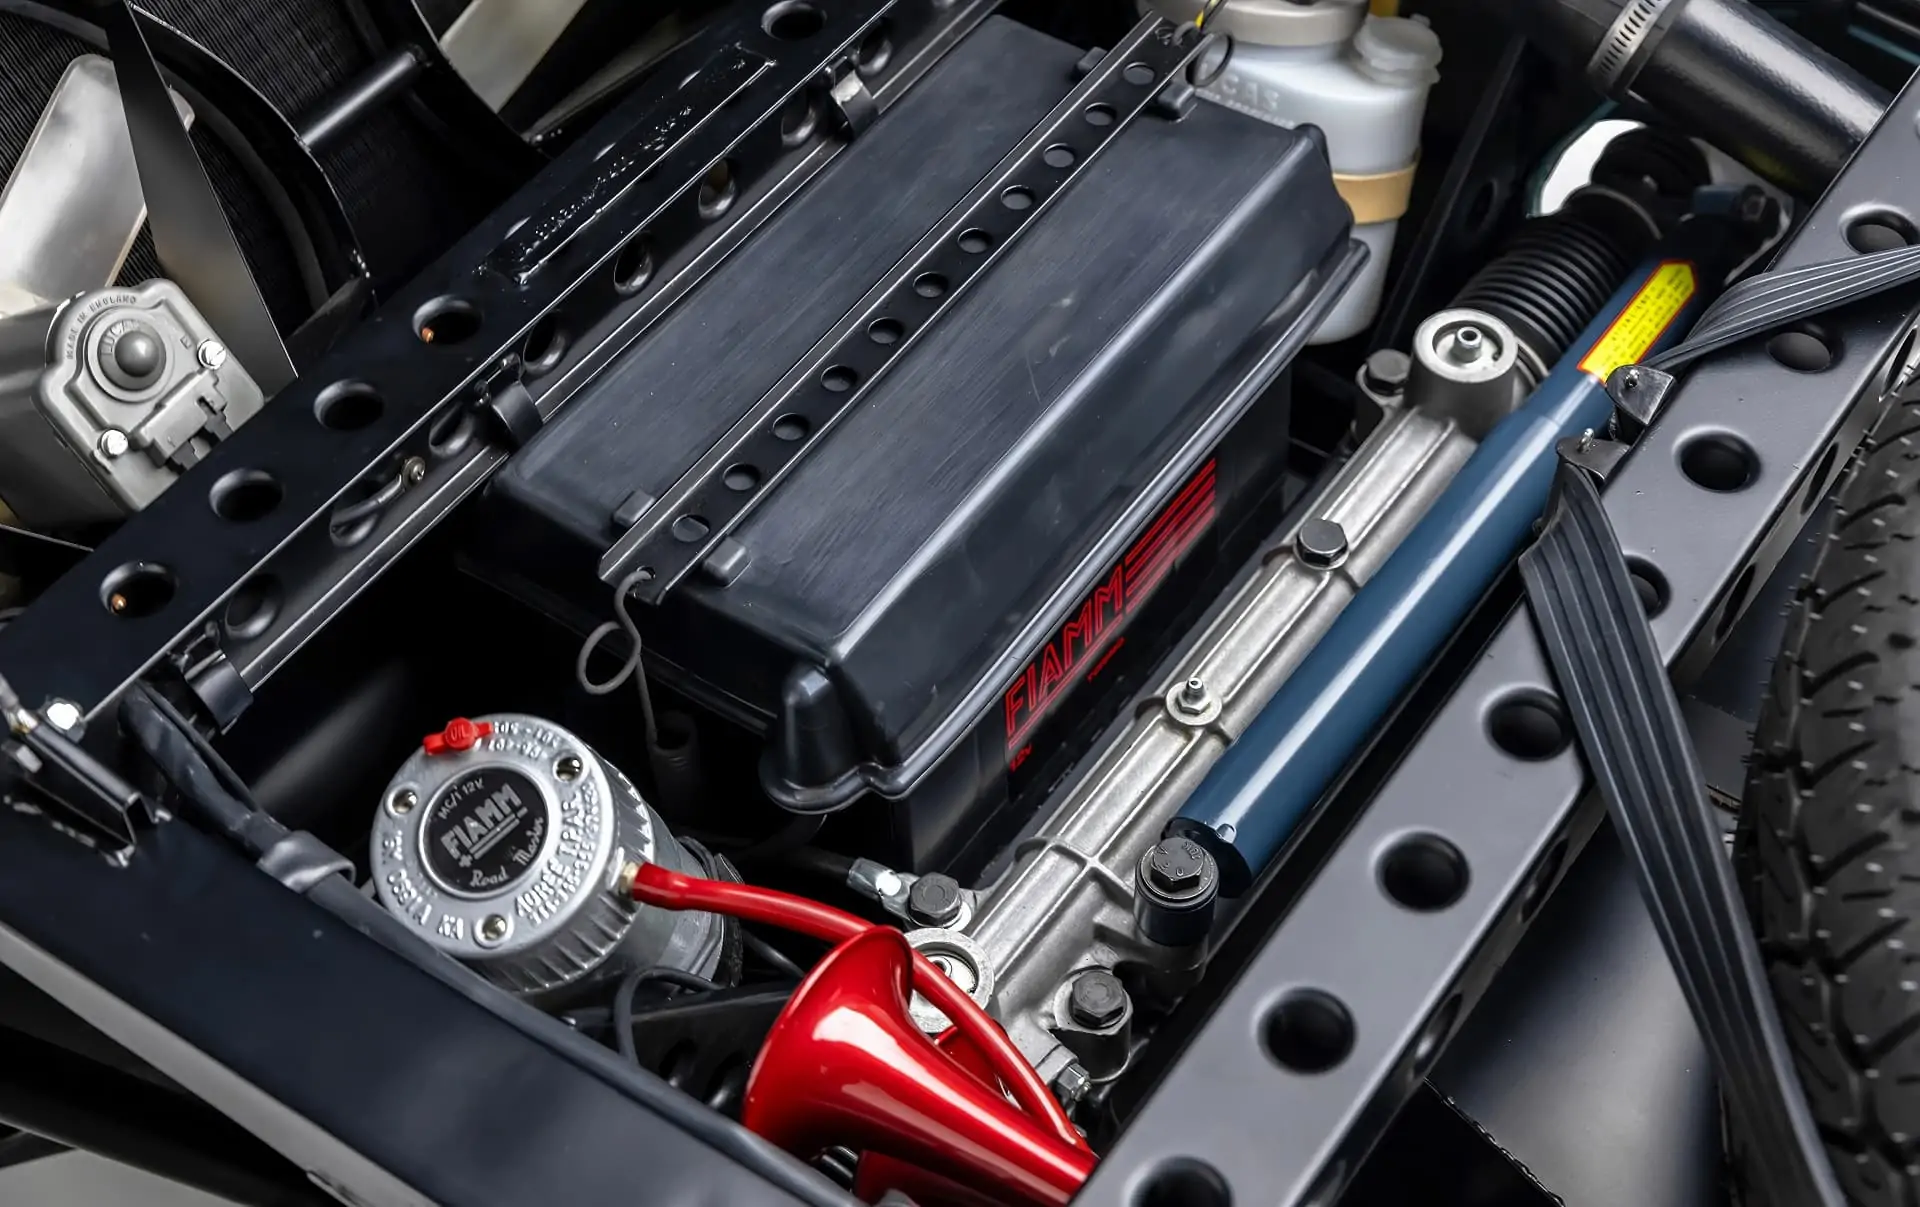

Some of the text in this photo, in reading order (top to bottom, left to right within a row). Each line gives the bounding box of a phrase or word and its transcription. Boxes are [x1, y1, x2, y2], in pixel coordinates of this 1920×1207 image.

[1005, 564, 1124, 737] FIAMM
[462, 777, 484, 794] 12V
[441, 783, 522, 860] FIAMM
[469, 865, 509, 887] Road
